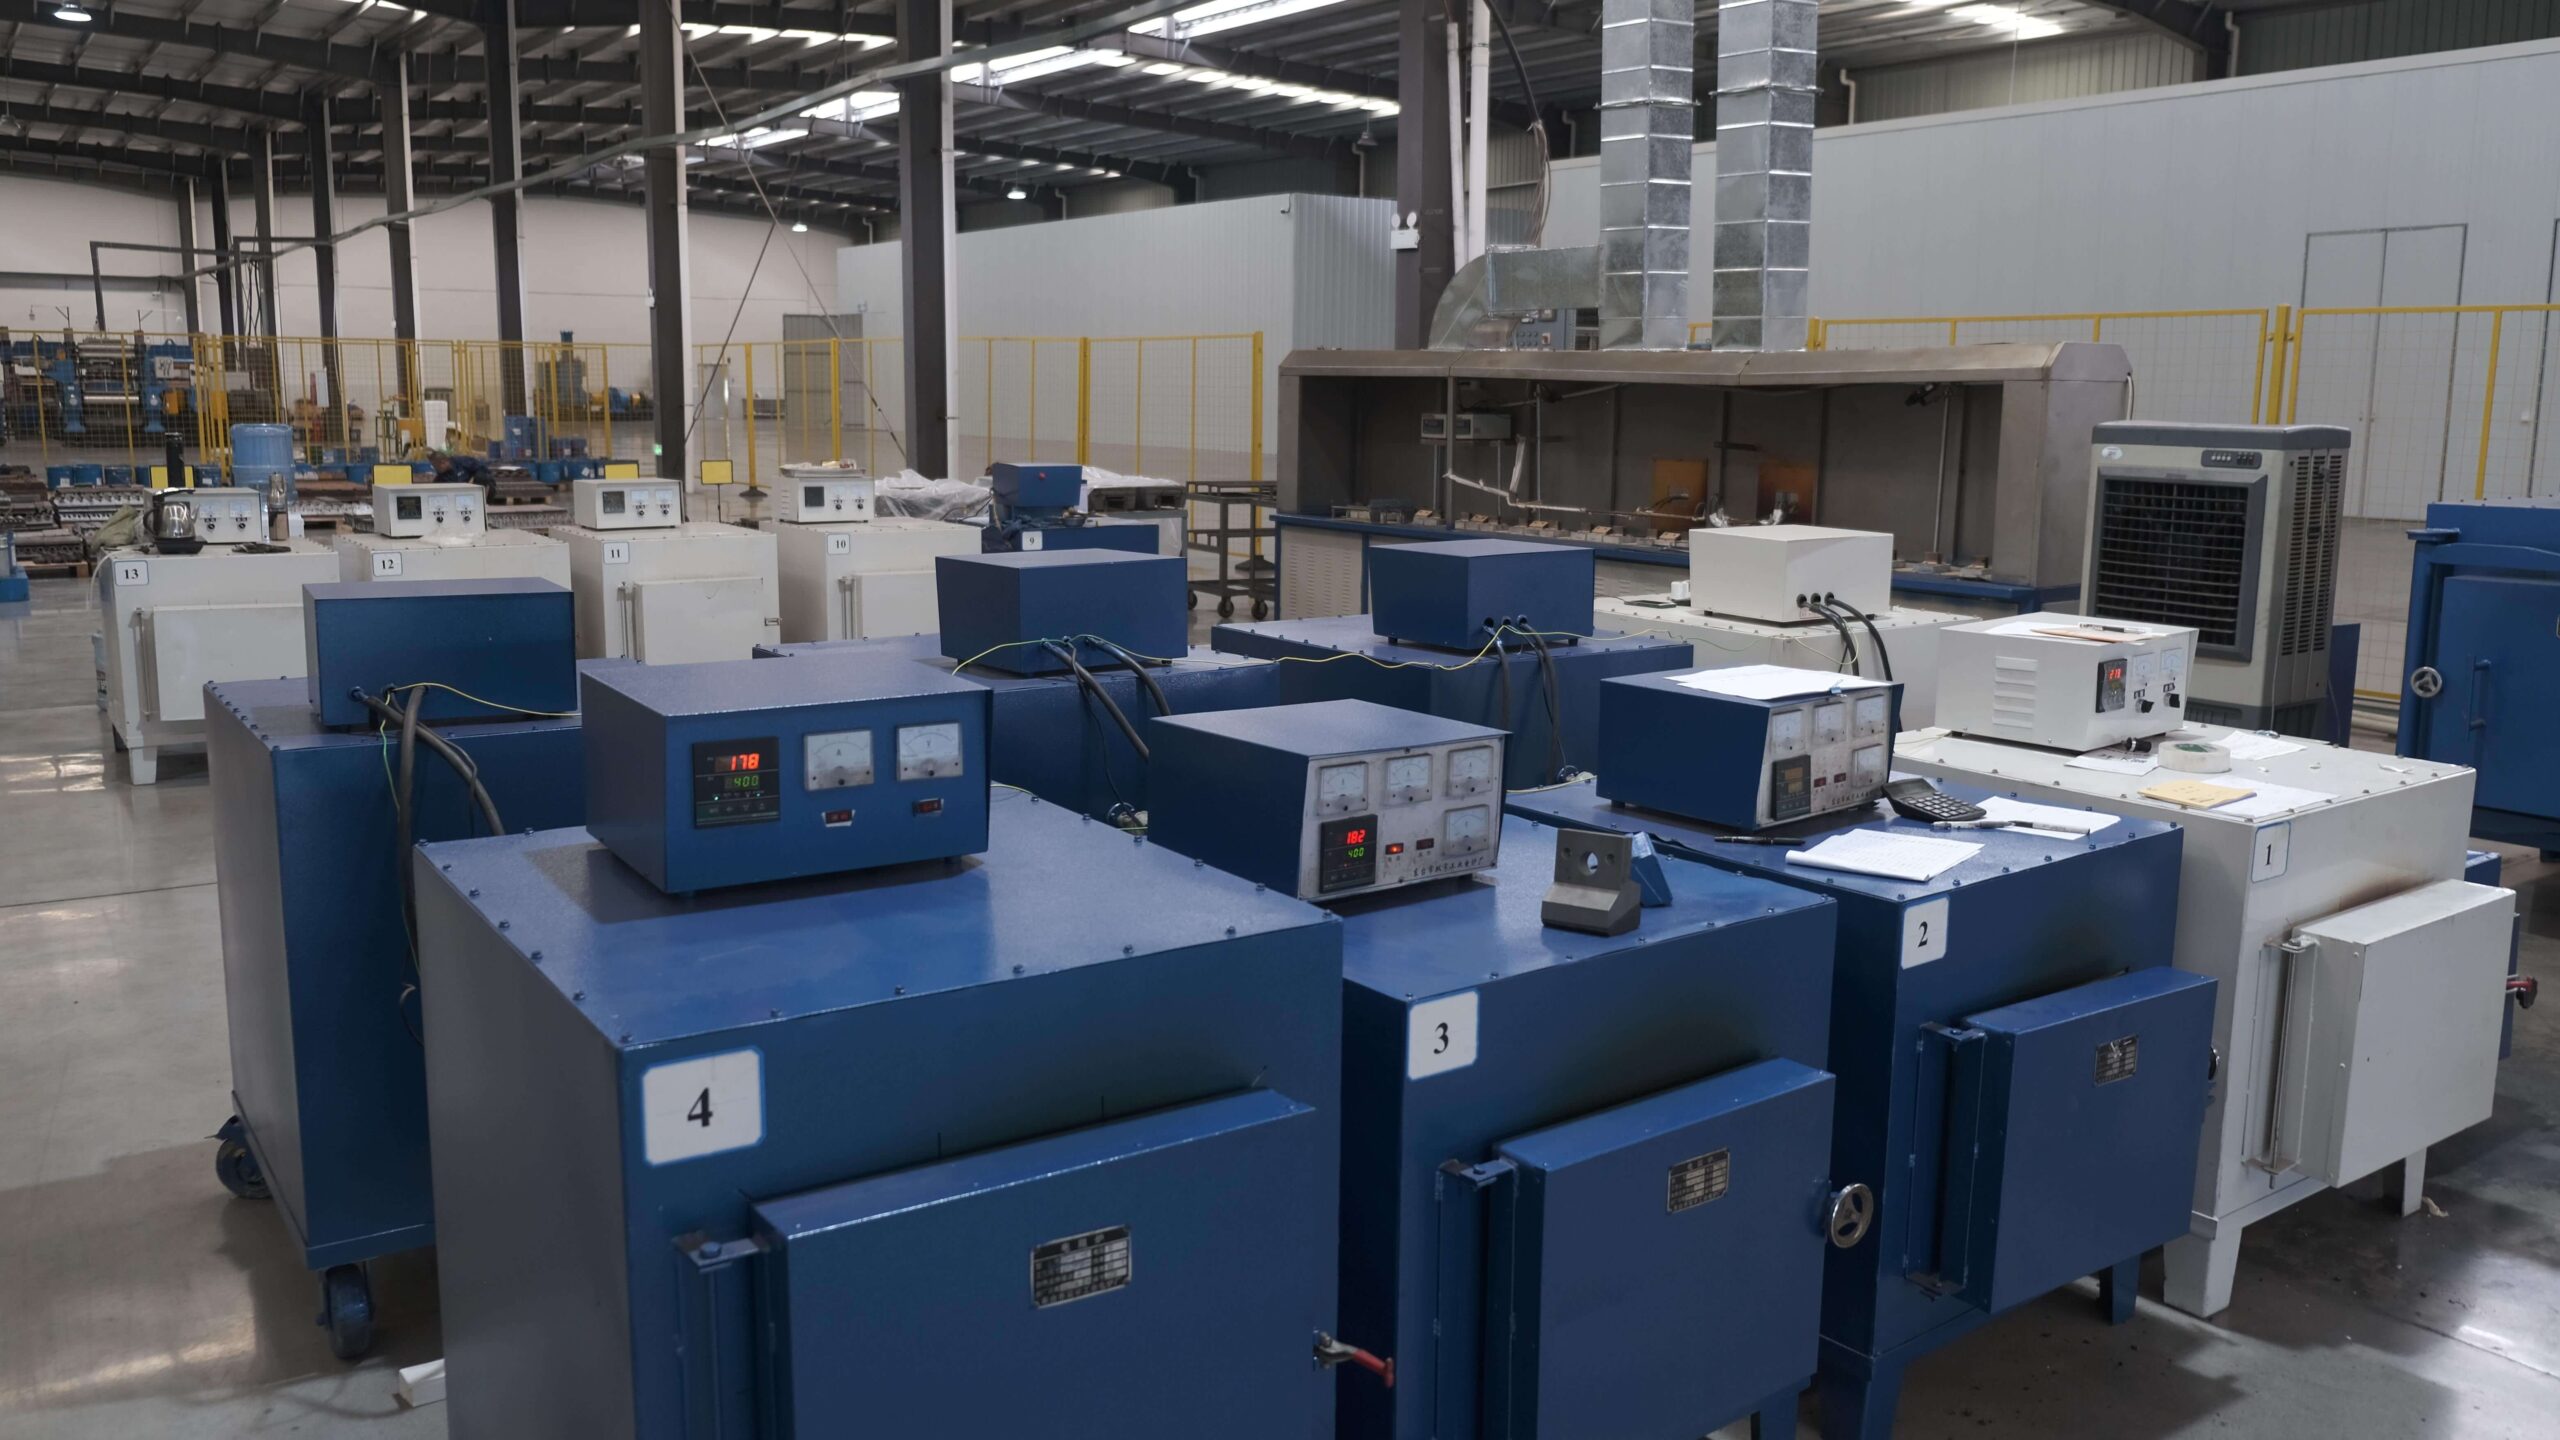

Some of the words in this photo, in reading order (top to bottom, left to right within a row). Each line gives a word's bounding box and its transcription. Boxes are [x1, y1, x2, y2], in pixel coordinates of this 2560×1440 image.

[835, 539, 847, 549] 10
[1029, 536, 1035, 545] 9
[610, 549, 621, 559] 11
[381, 559, 394, 570] 12
[124, 568, 139, 580] 13
[730, 752, 760, 771] 178
[734, 775, 759, 788] 400
[1346, 828, 1366, 845] 182
[1347, 846, 1365, 859] 400
[2264, 843, 2272, 866] 1
[1917, 920, 1929, 948] 2
[1433, 1022, 1449, 1054] 3
[686, 1086, 713, 1127] 4
